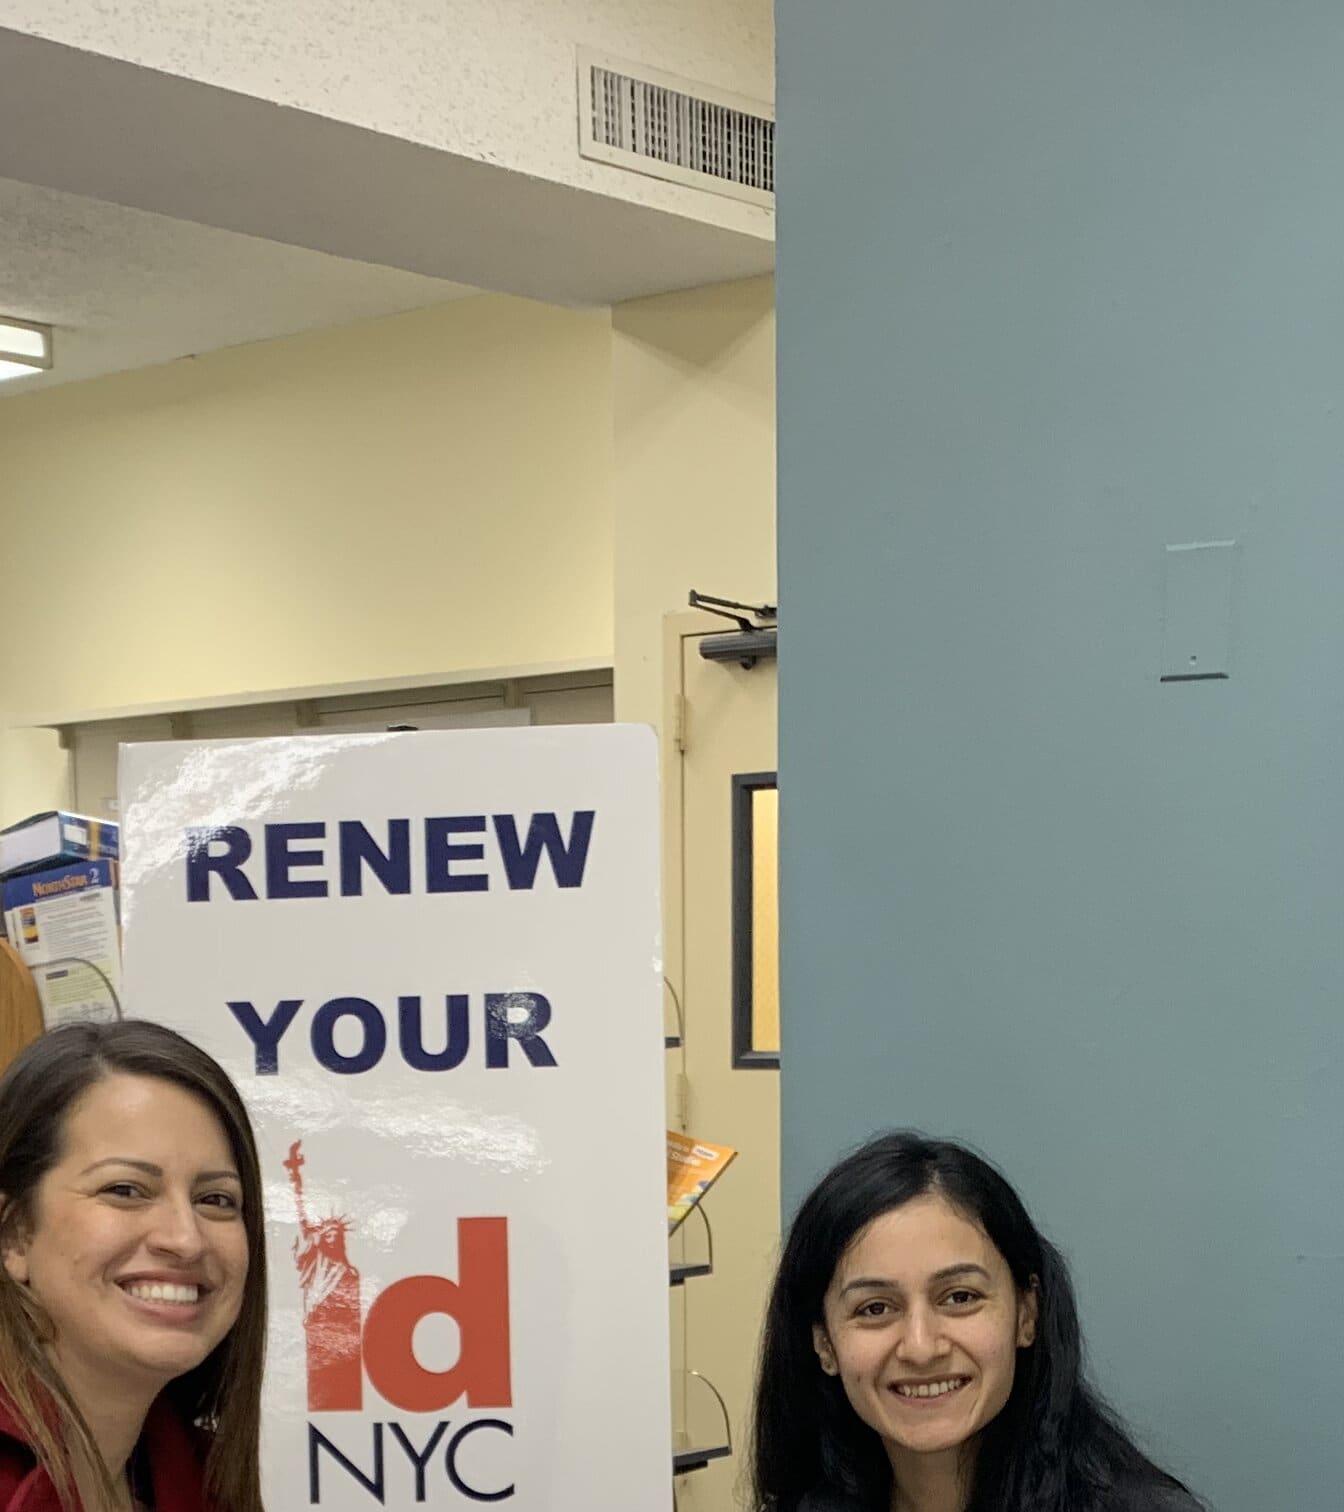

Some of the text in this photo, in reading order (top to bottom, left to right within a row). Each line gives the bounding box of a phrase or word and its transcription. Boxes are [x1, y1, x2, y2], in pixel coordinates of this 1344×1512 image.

[89, 868, 99, 883] 2
[184, 809, 595, 902] RENEW
[228, 990, 559, 1076] YOUR
[284, 1171, 513, 1413] id
[308, 1417, 516, 1506] NYC
